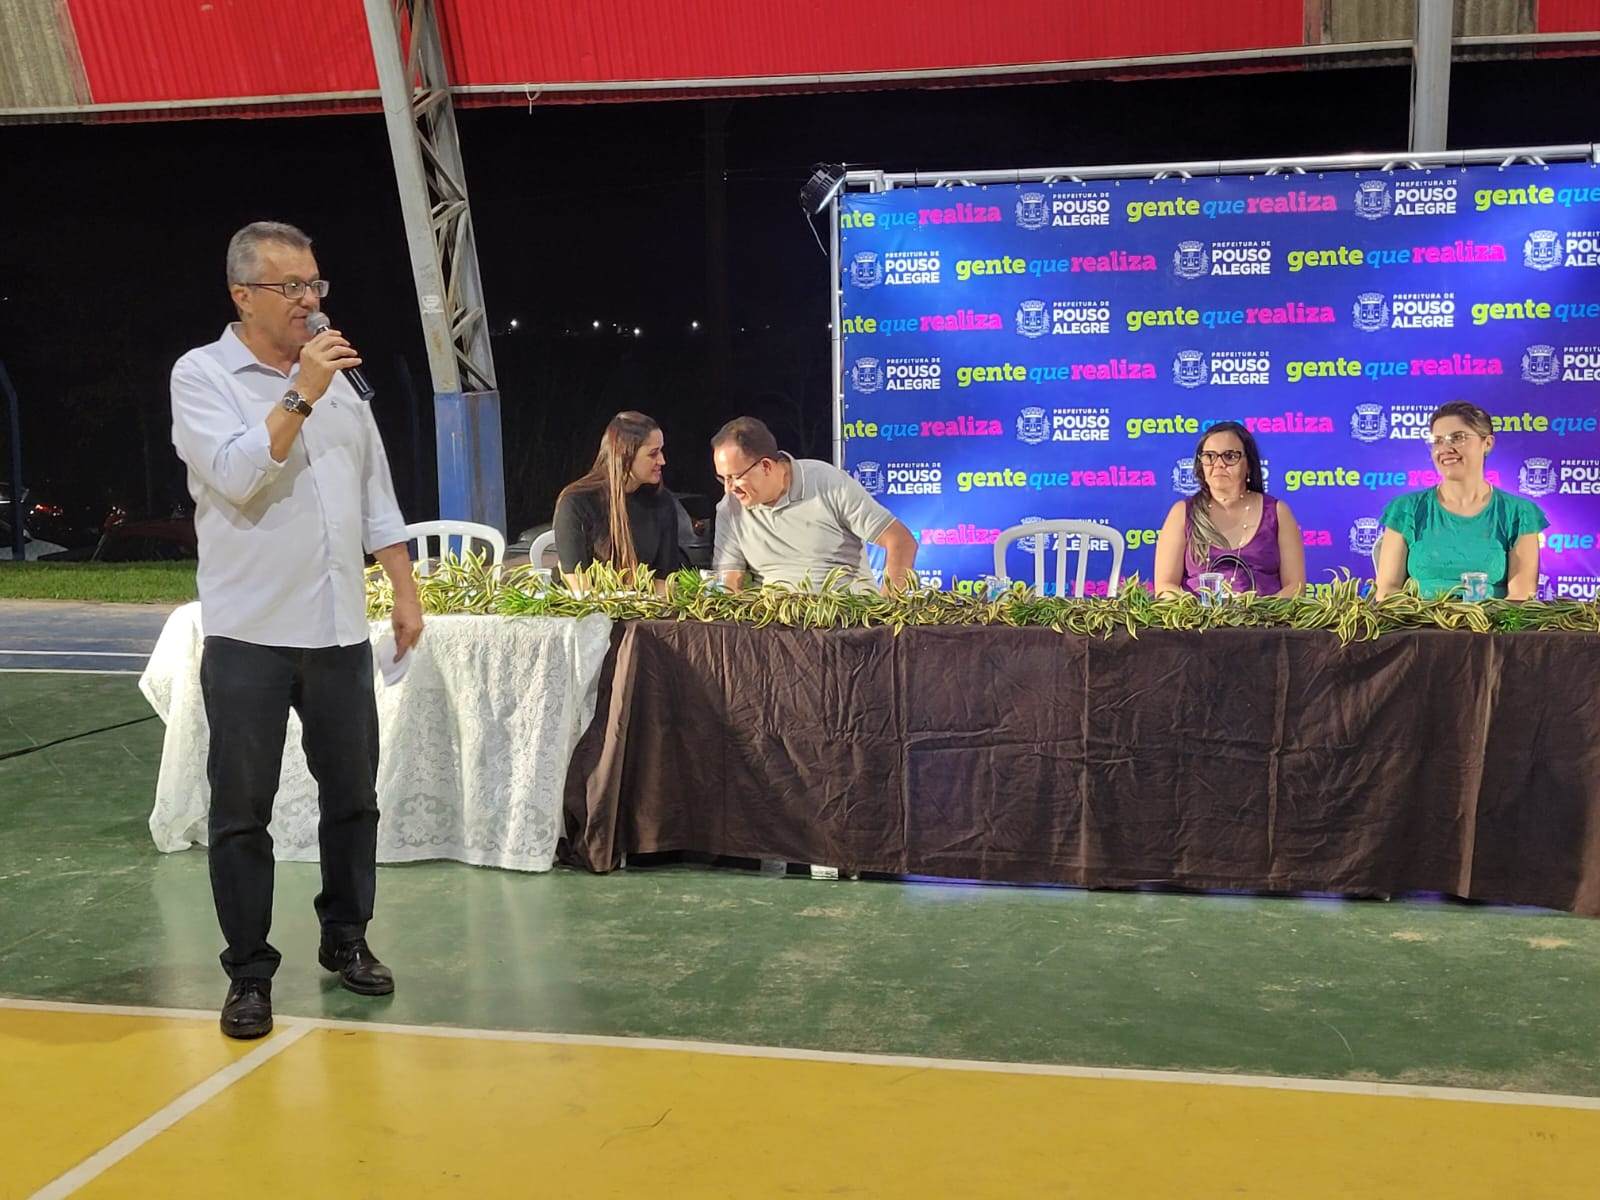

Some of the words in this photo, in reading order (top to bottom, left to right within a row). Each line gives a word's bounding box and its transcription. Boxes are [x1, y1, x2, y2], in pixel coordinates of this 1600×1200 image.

[1395, 187, 1458, 202] POUSO
[1474, 184, 1555, 212] gente
[1557, 186, 1600, 208] que
[1052, 198, 1110, 214] POUSO
[1126, 197, 1200, 223] gente
[1203, 199, 1245, 219] que
[1246, 191, 1338, 214] realiza
[1394, 202, 1457, 216] ALEGRE
[840, 209, 875, 229] nte
[878, 211, 917, 230] que
[918, 203, 1002, 225] realiza
[1051, 213, 1110, 227] ALEGRE
[1566, 238, 1600, 254] POU
[1211, 248, 1271, 263] POUSO
[1287, 246, 1363, 272] gente
[1366, 248, 1410, 269] que
[1412, 240, 1507, 264] realiza
[1564, 253, 1600, 267] ALE
[884, 257, 940, 273] POUSO
[955, 255, 1026, 281] gente
[1029, 258, 1069, 278] que
[1070, 251, 1157, 273] realiza
[1210, 262, 1271, 276] ALEGRE
[884, 272, 940, 285] ALEGRE
[1052, 307, 1110, 322] POUSO
[1392, 300, 1455, 315] POUSO
[1471, 299, 1551, 326] gente
[1554, 302, 1600, 323] que
[842, 315, 877, 334] nte
[879, 316, 918, 336] que
[920, 310, 1003, 332] realiza
[1126, 306, 1199, 332] gente
[1202, 309, 1245, 329] que
[1246, 302, 1336, 324] realiza
[1391, 315, 1454, 329] ALEGRE
[1051, 321, 1110, 335] ALEGRE
[1211, 358, 1270, 373] POUSO
[1286, 357, 1362, 383] gente
[1364, 360, 1408, 381] que
[1410, 354, 1503, 376] realiza
[1563, 353, 1600, 369] POU
[886, 364, 941, 378] POUSO
[956, 362, 1026, 387] gente
[1029, 365, 1069, 384] que
[1070, 358, 1157, 380] realiza
[1210, 372, 1270, 385] ALEGRE
[886, 378, 941, 391] ALEGRE
[1052, 415, 1110, 429] POUSO
[1126, 415, 1199, 439] gente
[1244, 412, 1334, 433] realiza
[1391, 412, 1433, 427] POU
[1491, 412, 1548, 432] ente
[1551, 416, 1598, 437] que
[843, 419, 878, 439] nte
[880, 421, 919, 441] que
[920, 416, 1003, 437] realiza
[1051, 429, 1110, 441] ALEGRE
[1390, 427, 1431, 440] ALEG
[887, 468, 942, 482] POUSO
[957, 467, 1027, 492] gente
[1029, 471, 1069, 491] que
[1071, 465, 1156, 486] realiza
[1285, 467, 1360, 491] gente
[1363, 470, 1407, 491] que
[1560, 467, 1600, 481] POU
[886, 482, 942, 495] ALEGRE
[1559, 481, 1600, 495] ALEG
[1547, 533, 1594, 553] que
[1558, 583, 1600, 598] POU
